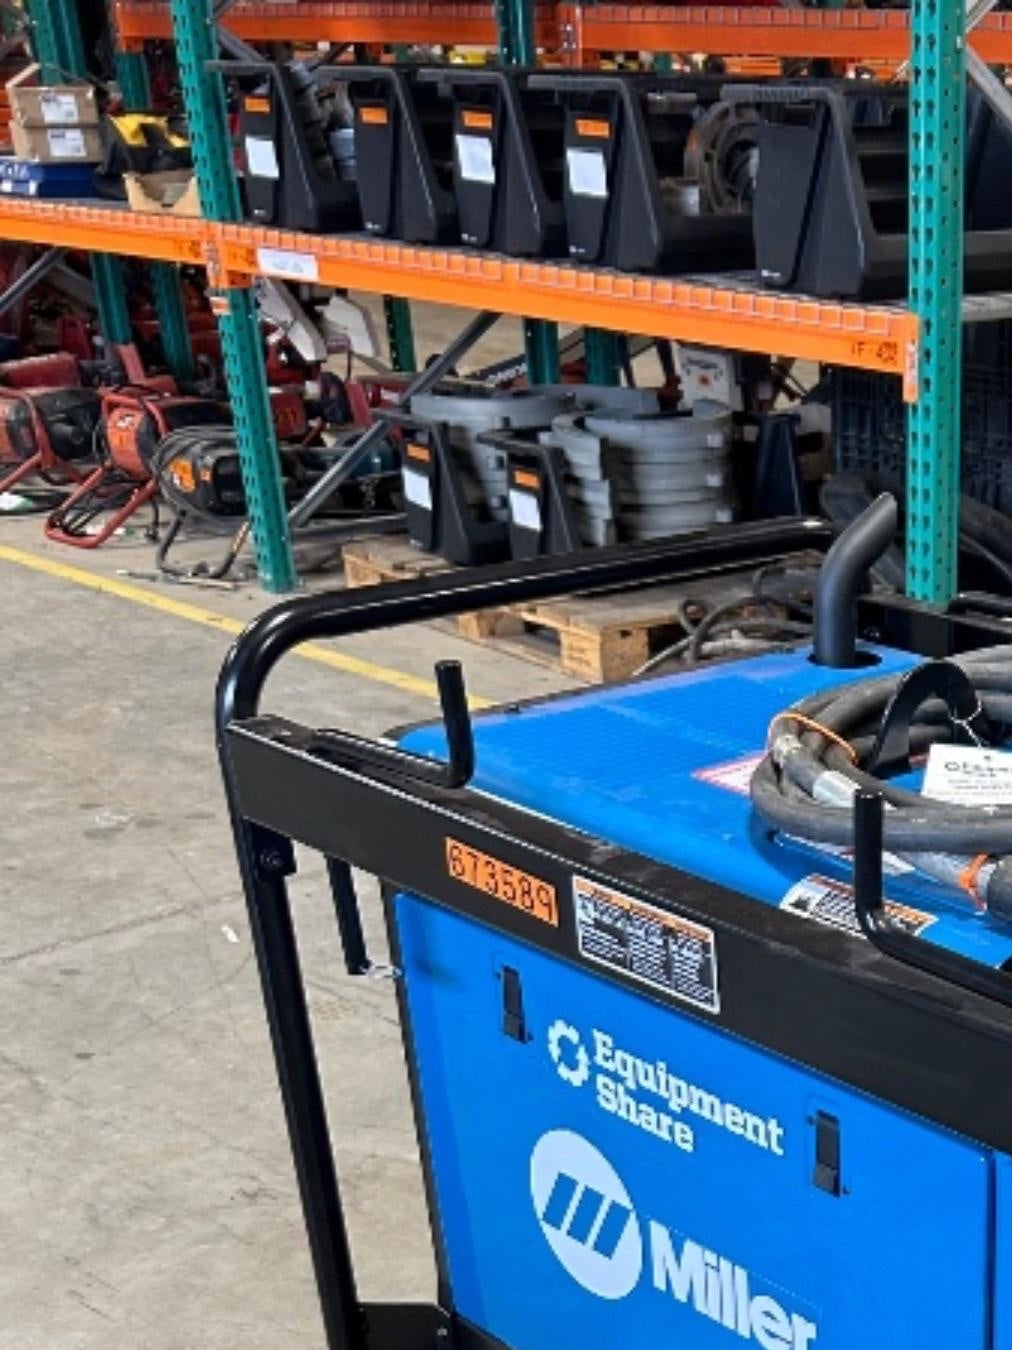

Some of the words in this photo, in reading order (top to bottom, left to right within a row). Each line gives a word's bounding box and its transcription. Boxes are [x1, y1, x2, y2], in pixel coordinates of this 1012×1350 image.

[449, 844, 553, 921] 673589
[592, 1028, 785, 1156] Equipment
[596, 1073, 695, 1153] Share
